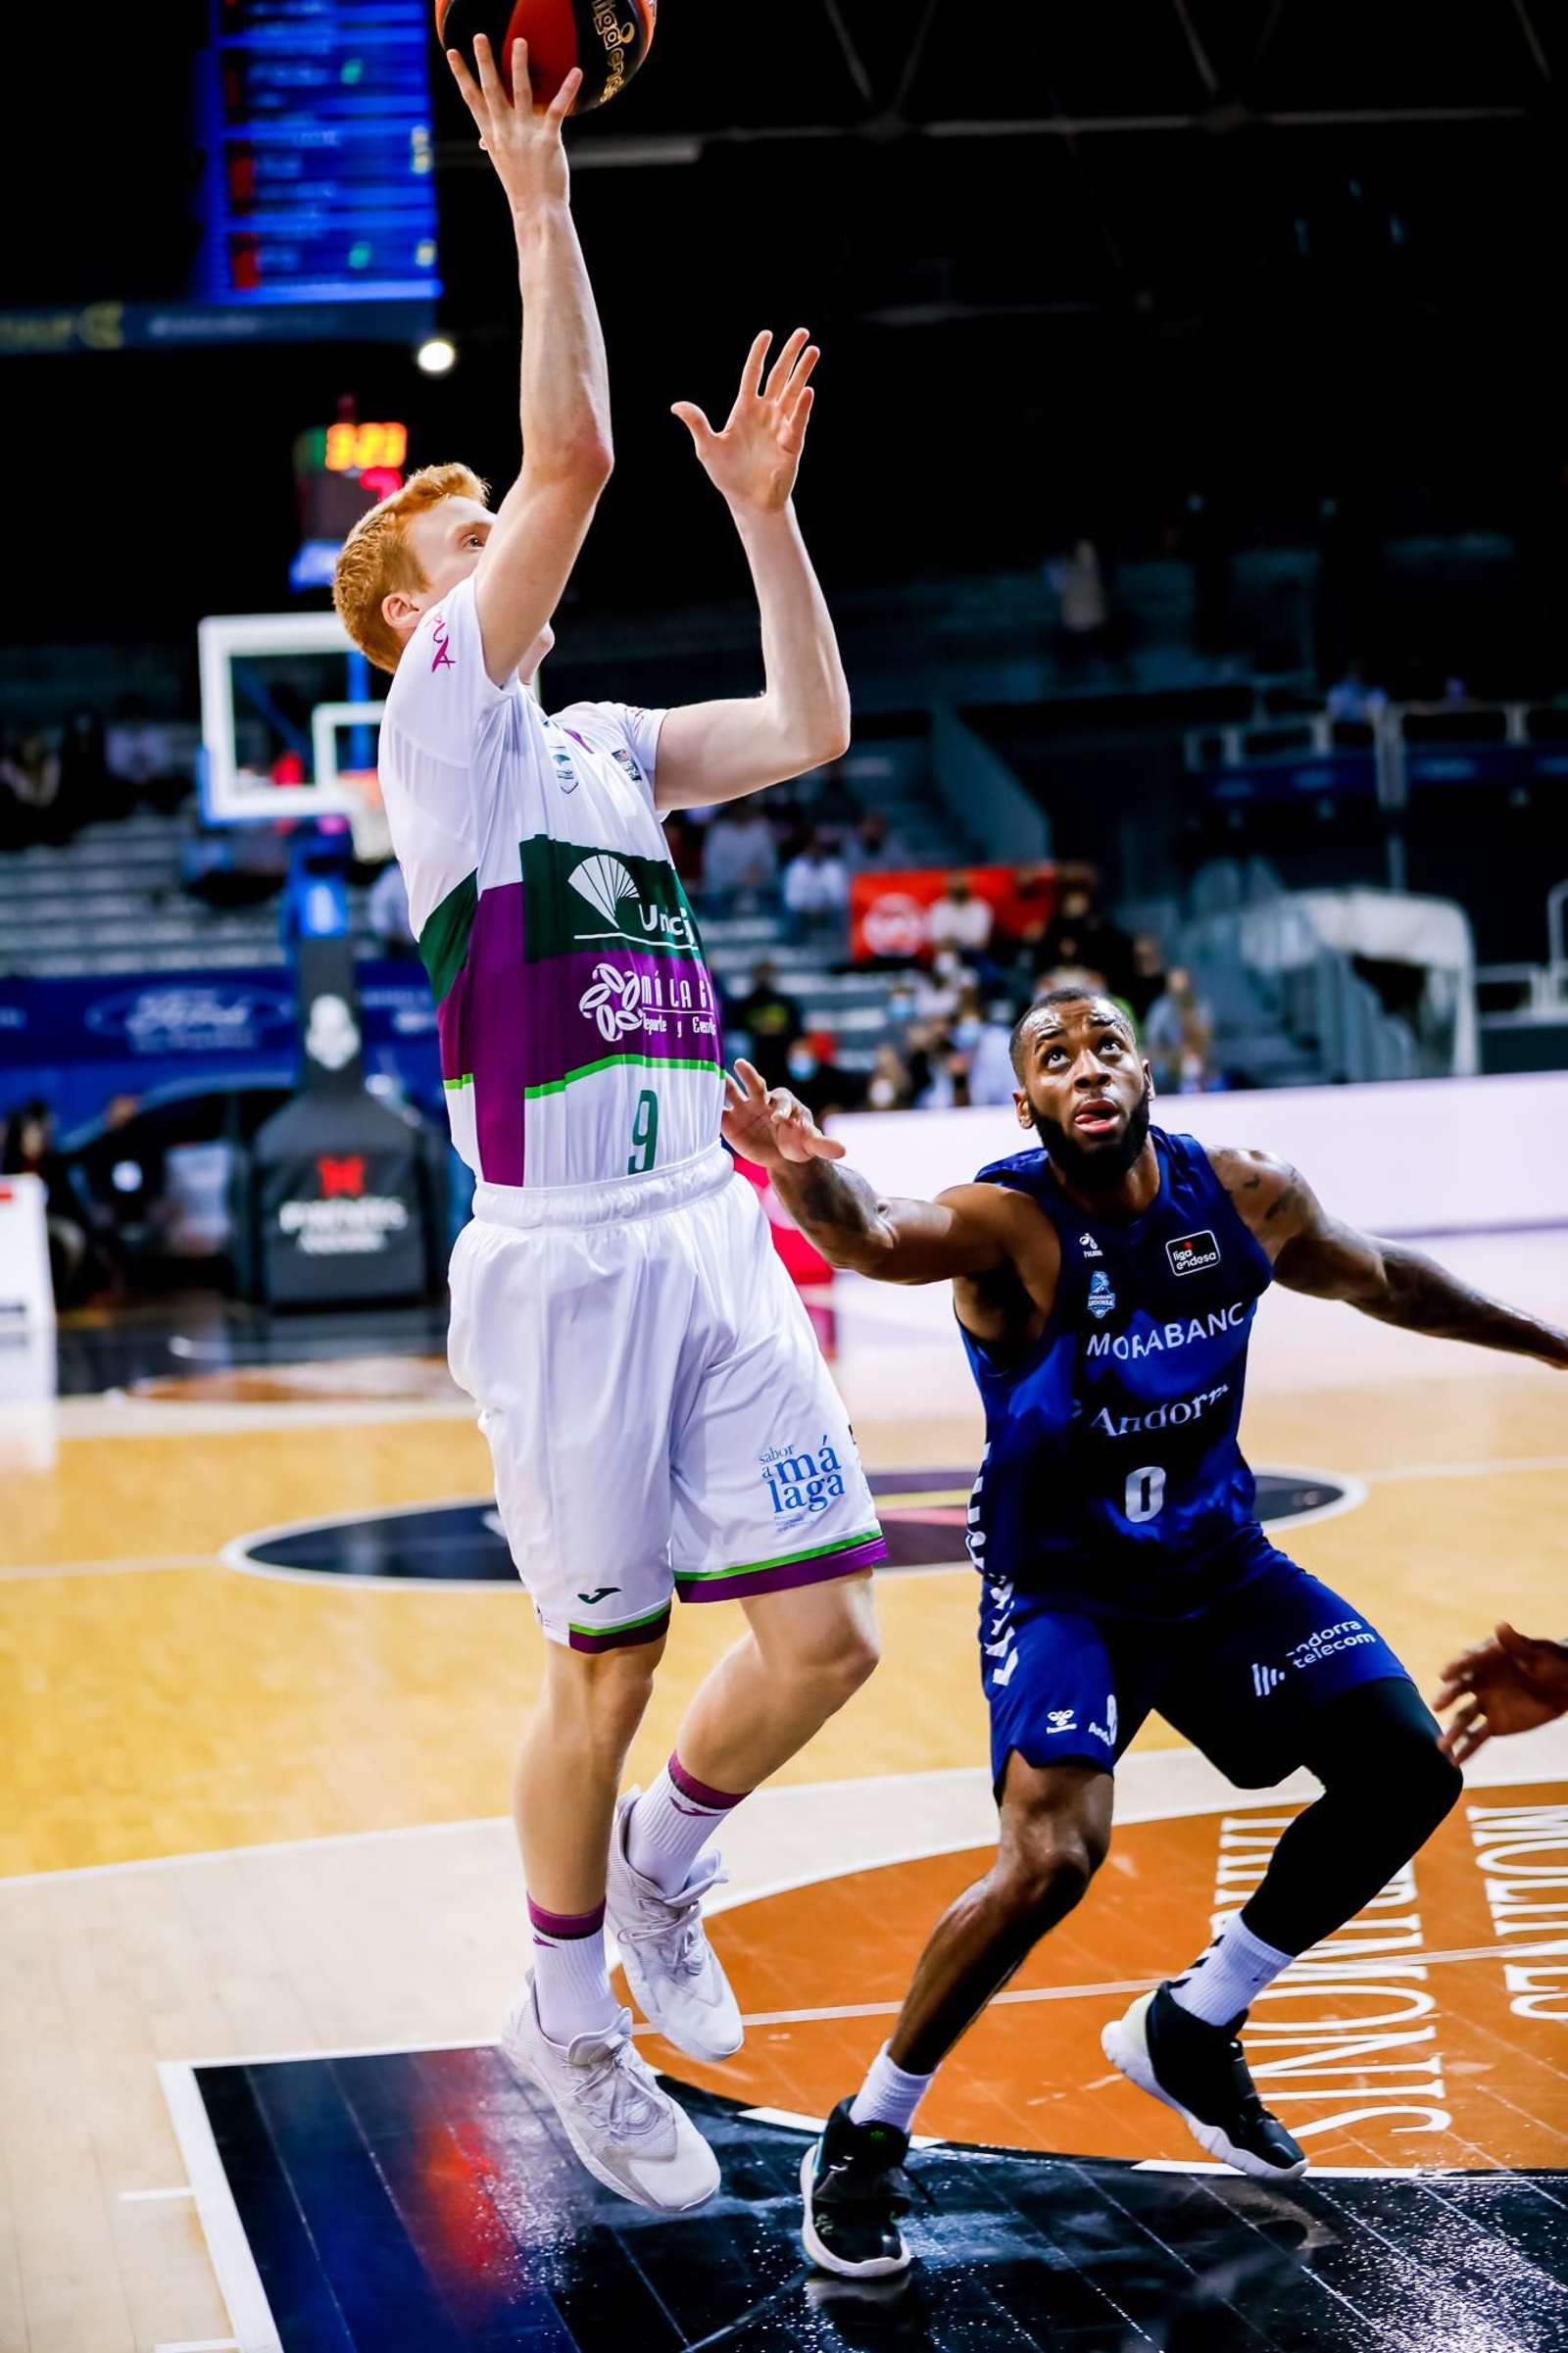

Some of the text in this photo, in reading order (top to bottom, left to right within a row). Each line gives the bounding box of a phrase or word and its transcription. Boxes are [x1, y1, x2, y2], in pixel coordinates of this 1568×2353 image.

[627, 1089, 660, 1175] 9
[1172, 1249, 1194, 1261] liga
[1176, 1251, 1217, 1270] endesa
[1086, 1301, 1245, 1360] MORABANC
[759, 1444, 796, 1465] sabor
[773, 1434, 842, 1486] má
[766, 1473, 846, 1514] laga
[1125, 1465, 1167, 1524] 0
[1293, 1633, 1377, 1669] telecom
